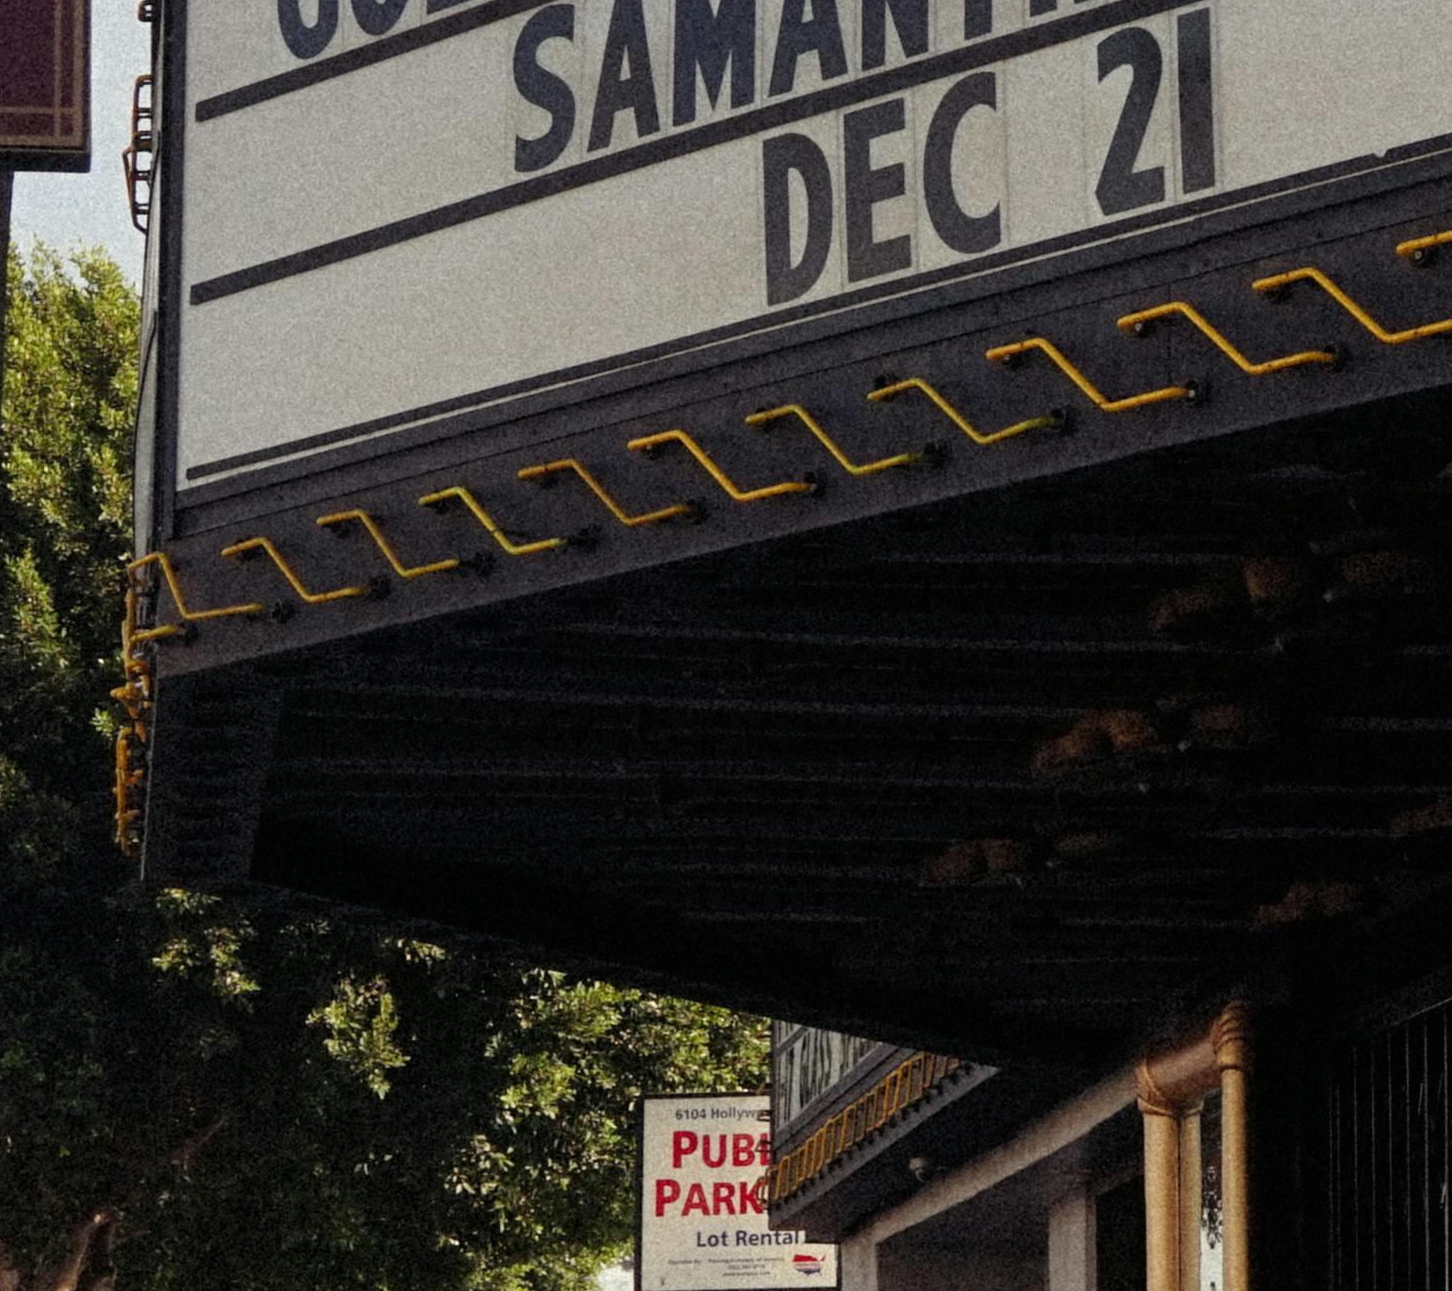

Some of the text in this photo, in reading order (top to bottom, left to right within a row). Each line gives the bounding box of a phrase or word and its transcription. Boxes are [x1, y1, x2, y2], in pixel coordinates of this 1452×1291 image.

[760, 7, 1219, 309] DEC 21
[675, 1109, 707, 1121] 6104
[697, 1230, 799, 1248] Lot Rental
